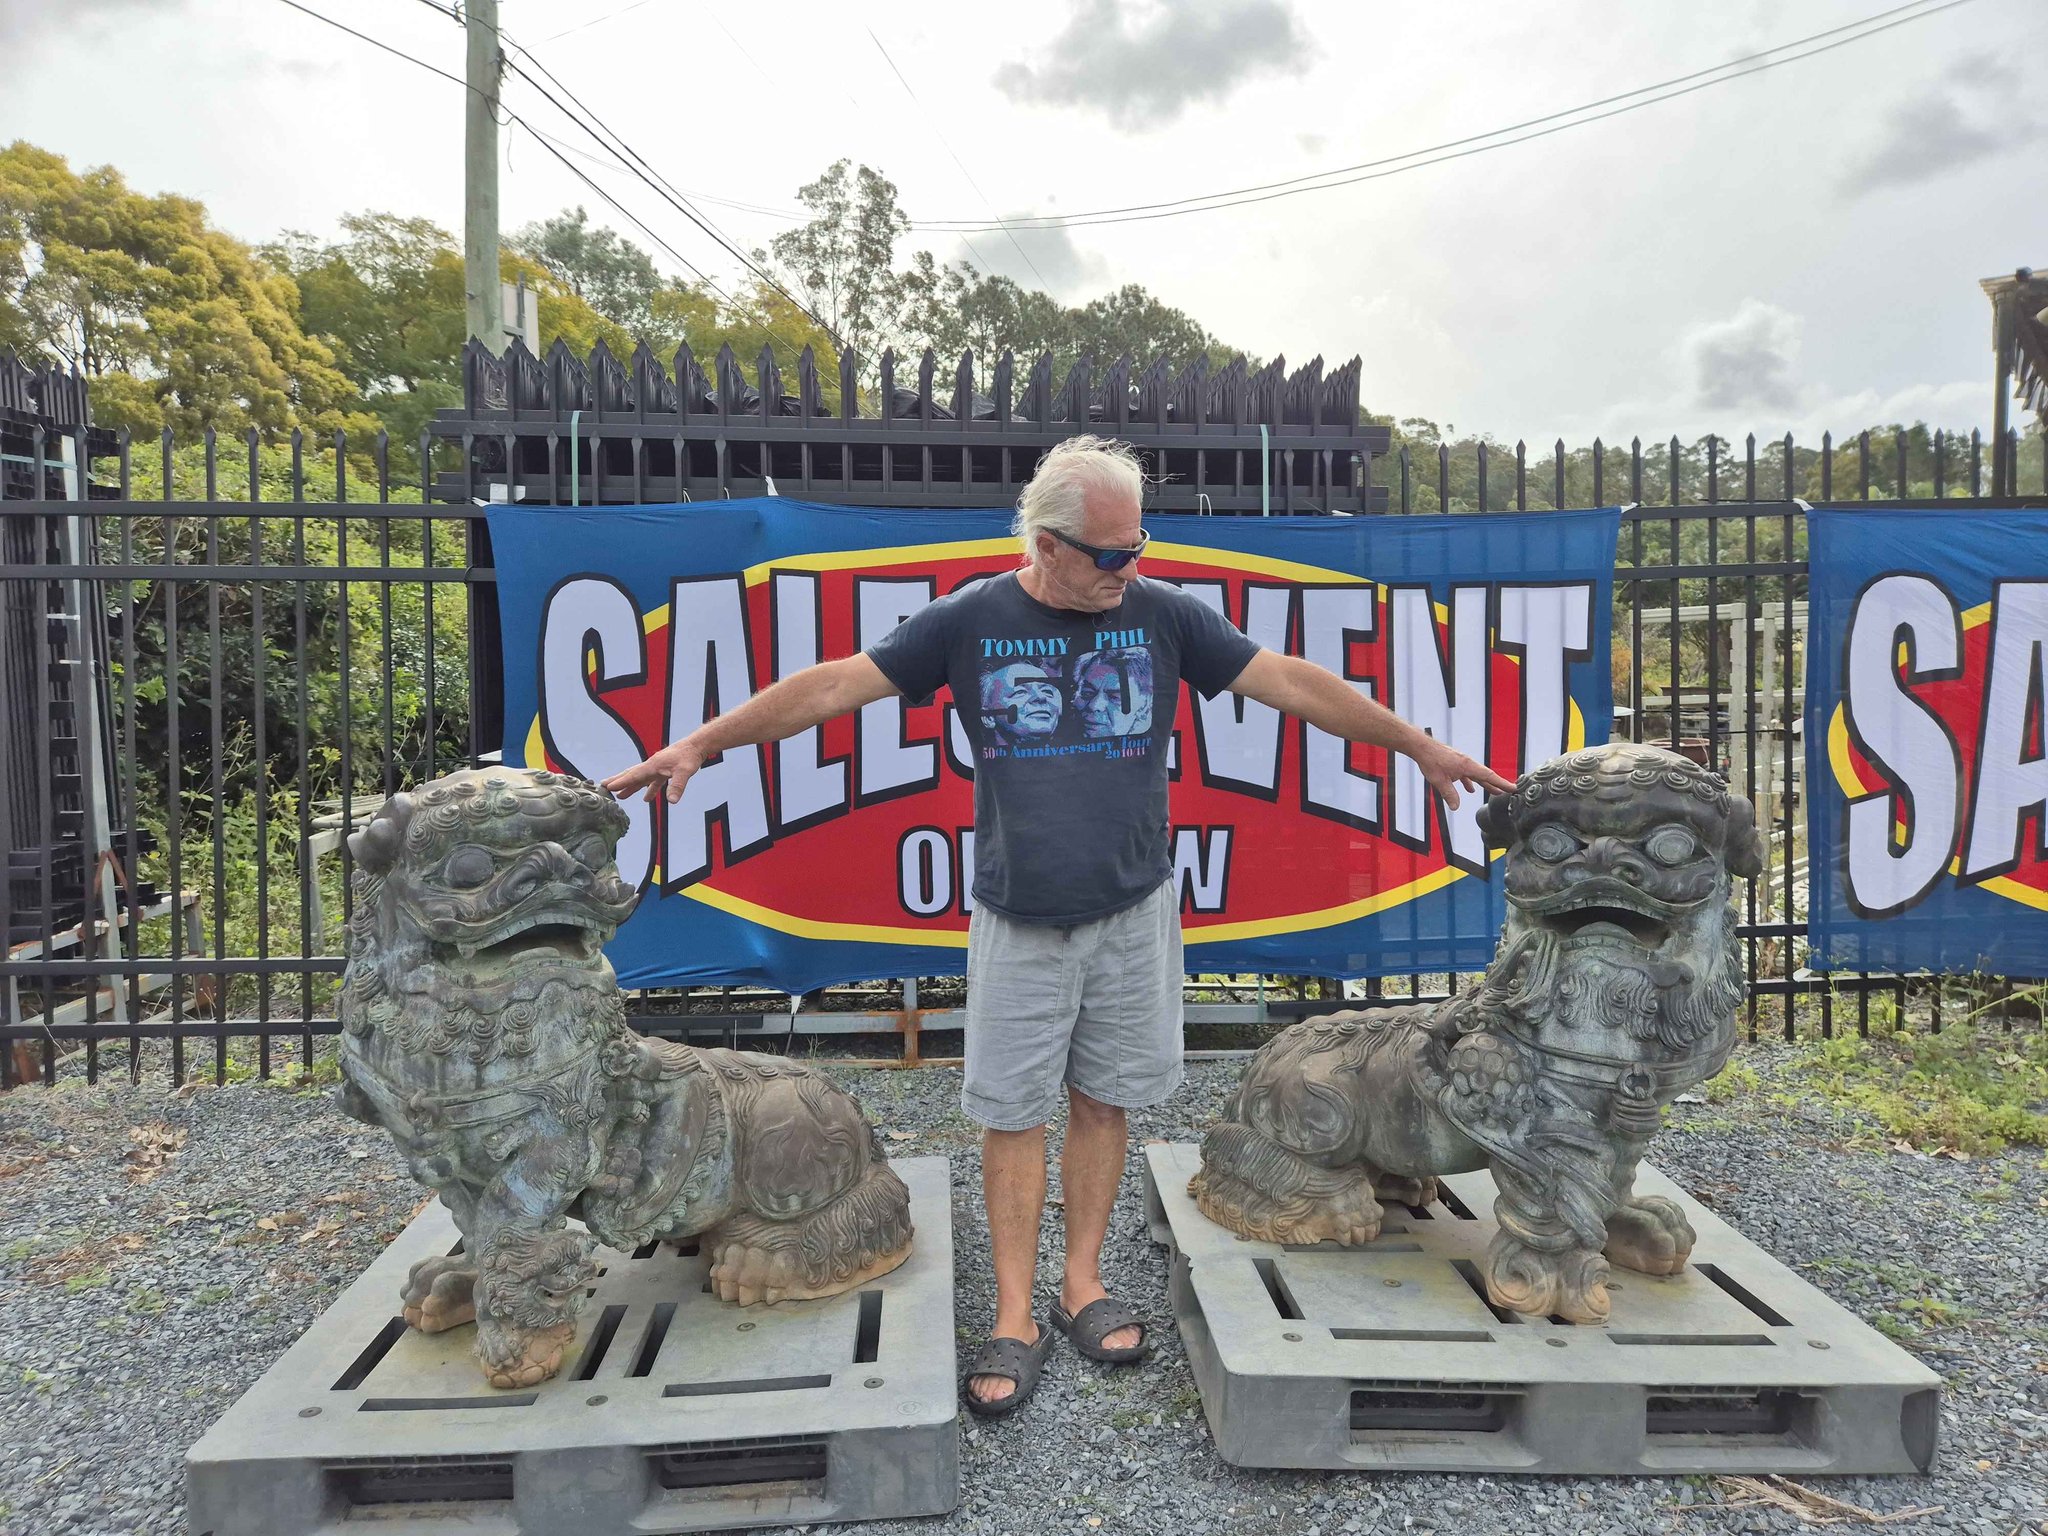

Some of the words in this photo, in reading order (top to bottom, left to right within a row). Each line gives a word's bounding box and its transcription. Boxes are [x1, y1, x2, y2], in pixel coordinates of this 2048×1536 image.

[980, 637, 1071, 657] TOMMY
[1095, 628, 1151, 650] PHIL
[537, 571, 1000, 926] SALE
[1152, 577, 1597, 882] VENT
[982, 746, 1007, 759] 50th
[1010, 740, 1113, 758] Anniversary
[1120, 735, 1153, 749] Tour
[896, 825, 973, 918] O
